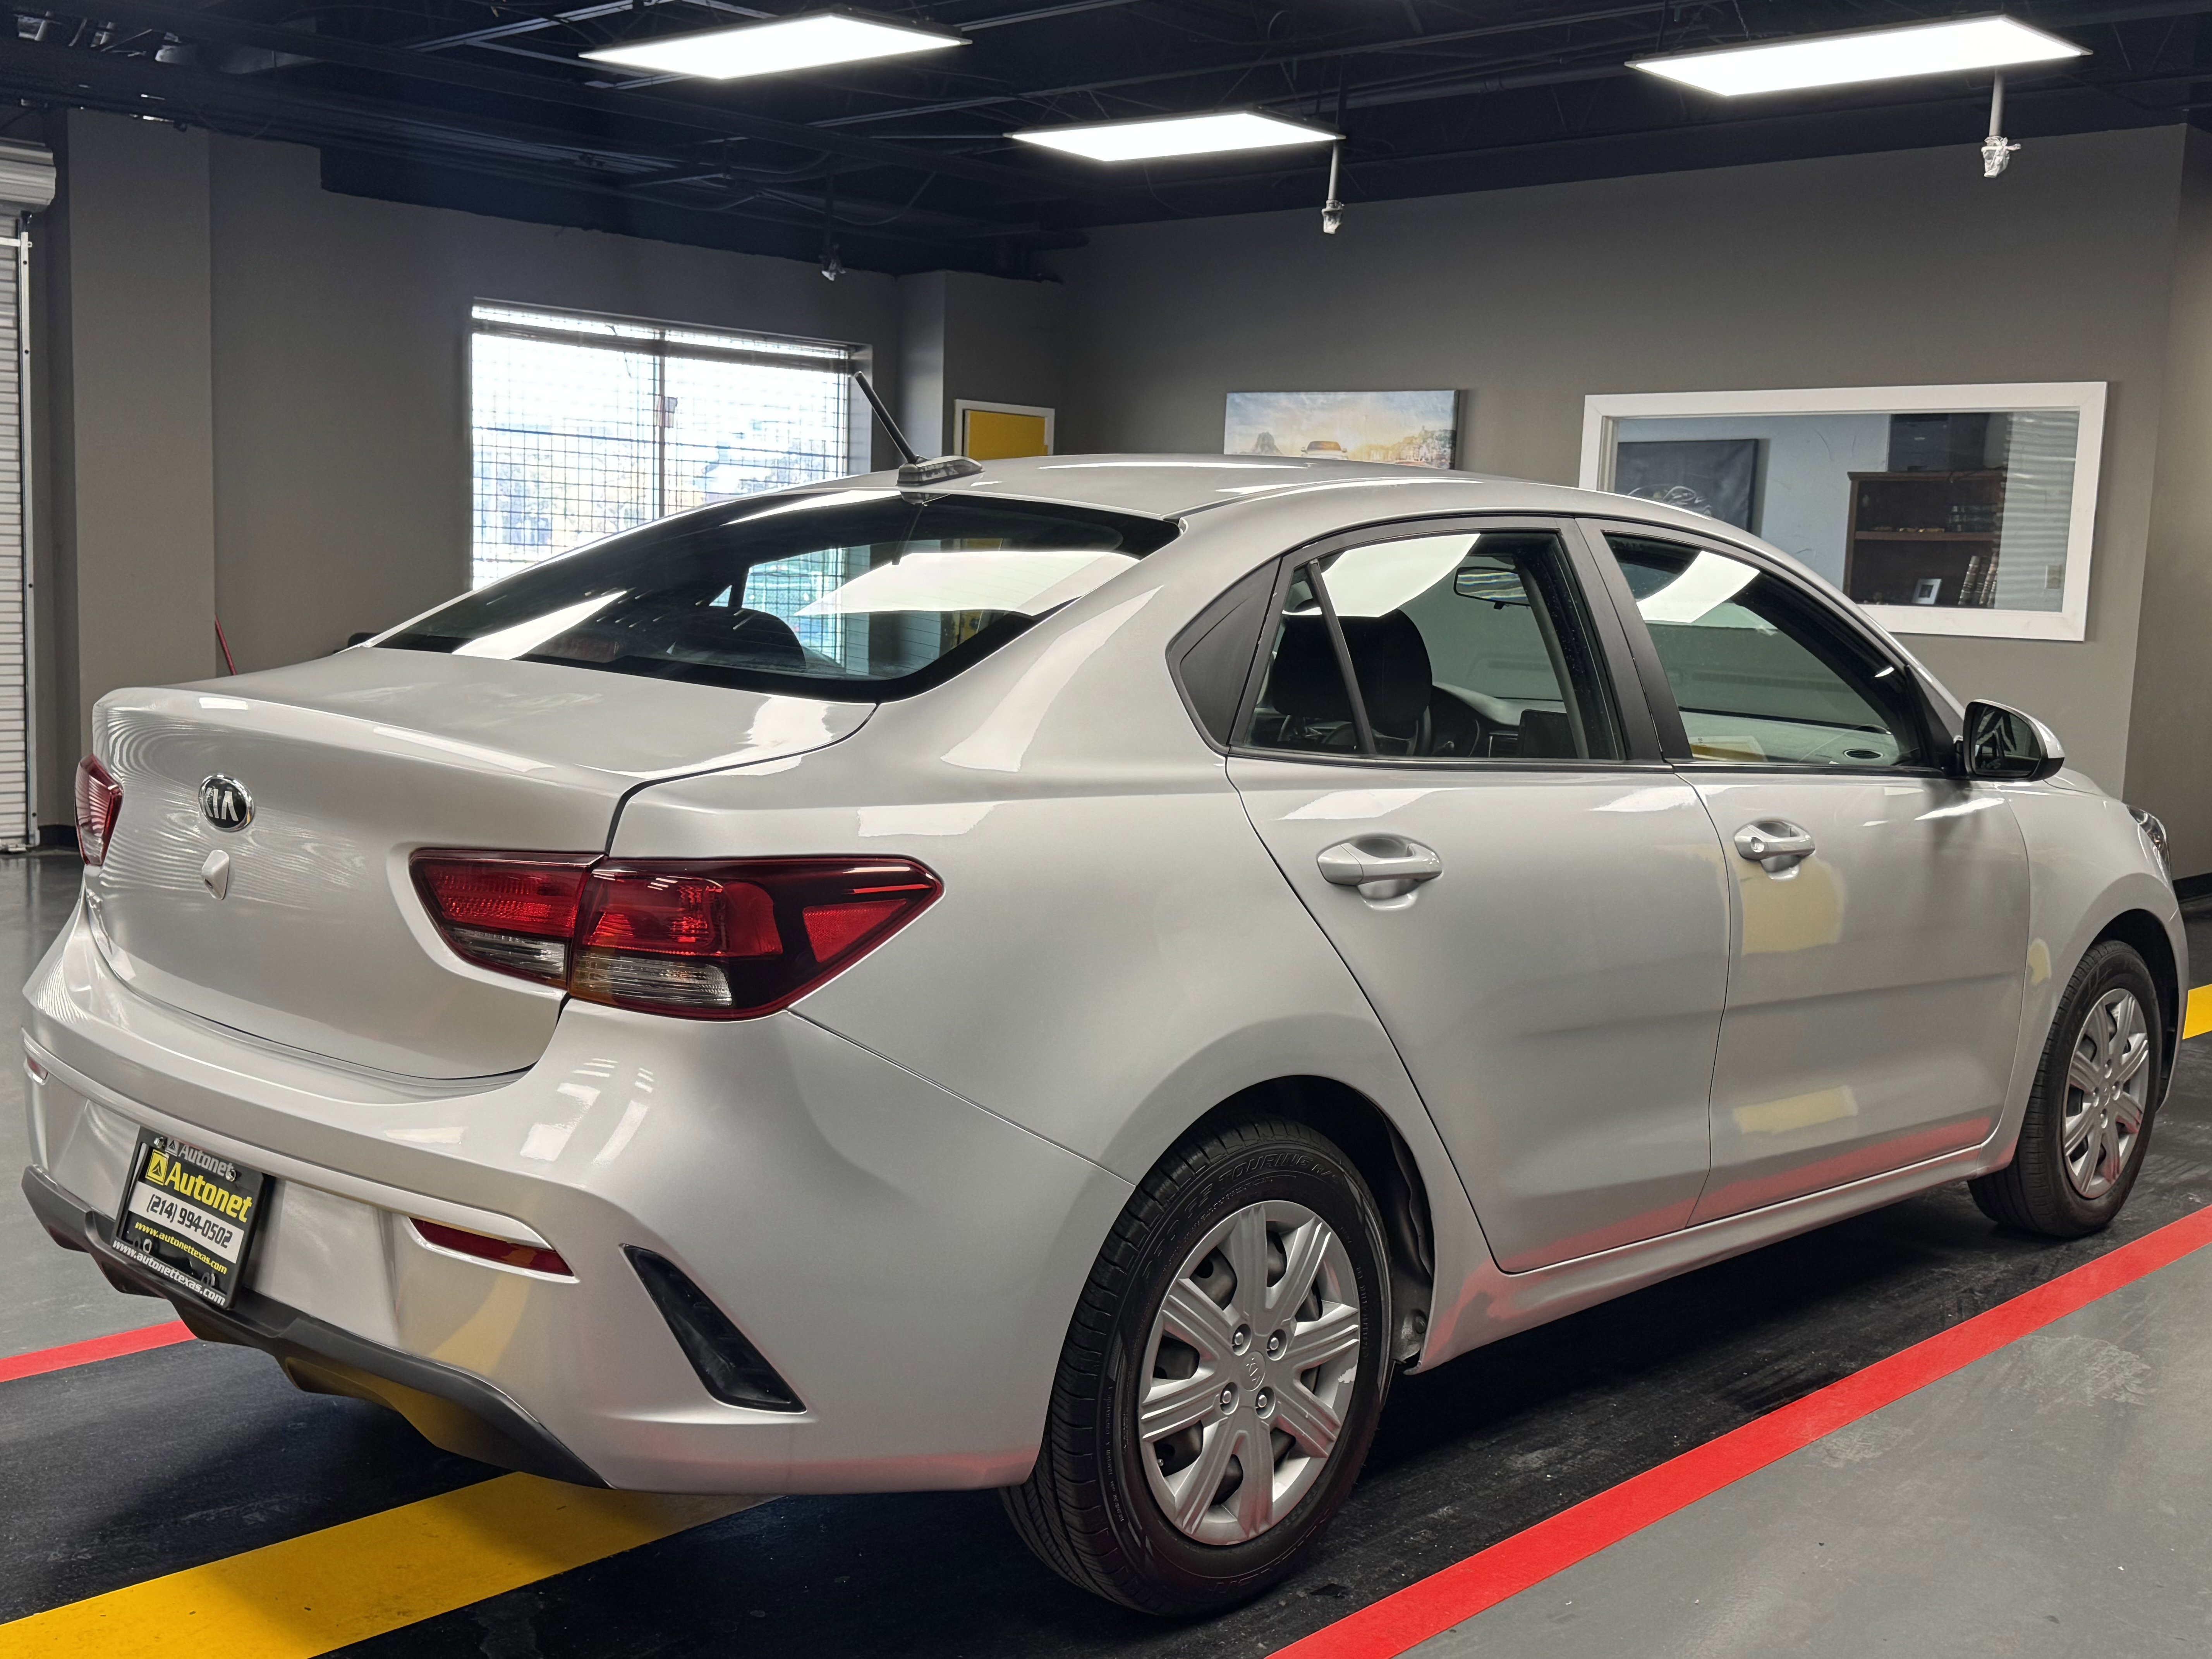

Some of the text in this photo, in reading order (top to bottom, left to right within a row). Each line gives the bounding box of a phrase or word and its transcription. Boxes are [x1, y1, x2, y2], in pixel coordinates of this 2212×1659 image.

[204, 787, 239, 821] KIA
[178, 1144, 234, 1177] Autonet
[163, 1161, 252, 1223] Autonet
[135, 1221, 227, 1274] www.autonettexas.com
[146, 1194, 233, 1249] (214) 994-0502
[112, 1240, 226, 1306] www.autonettexas.com
